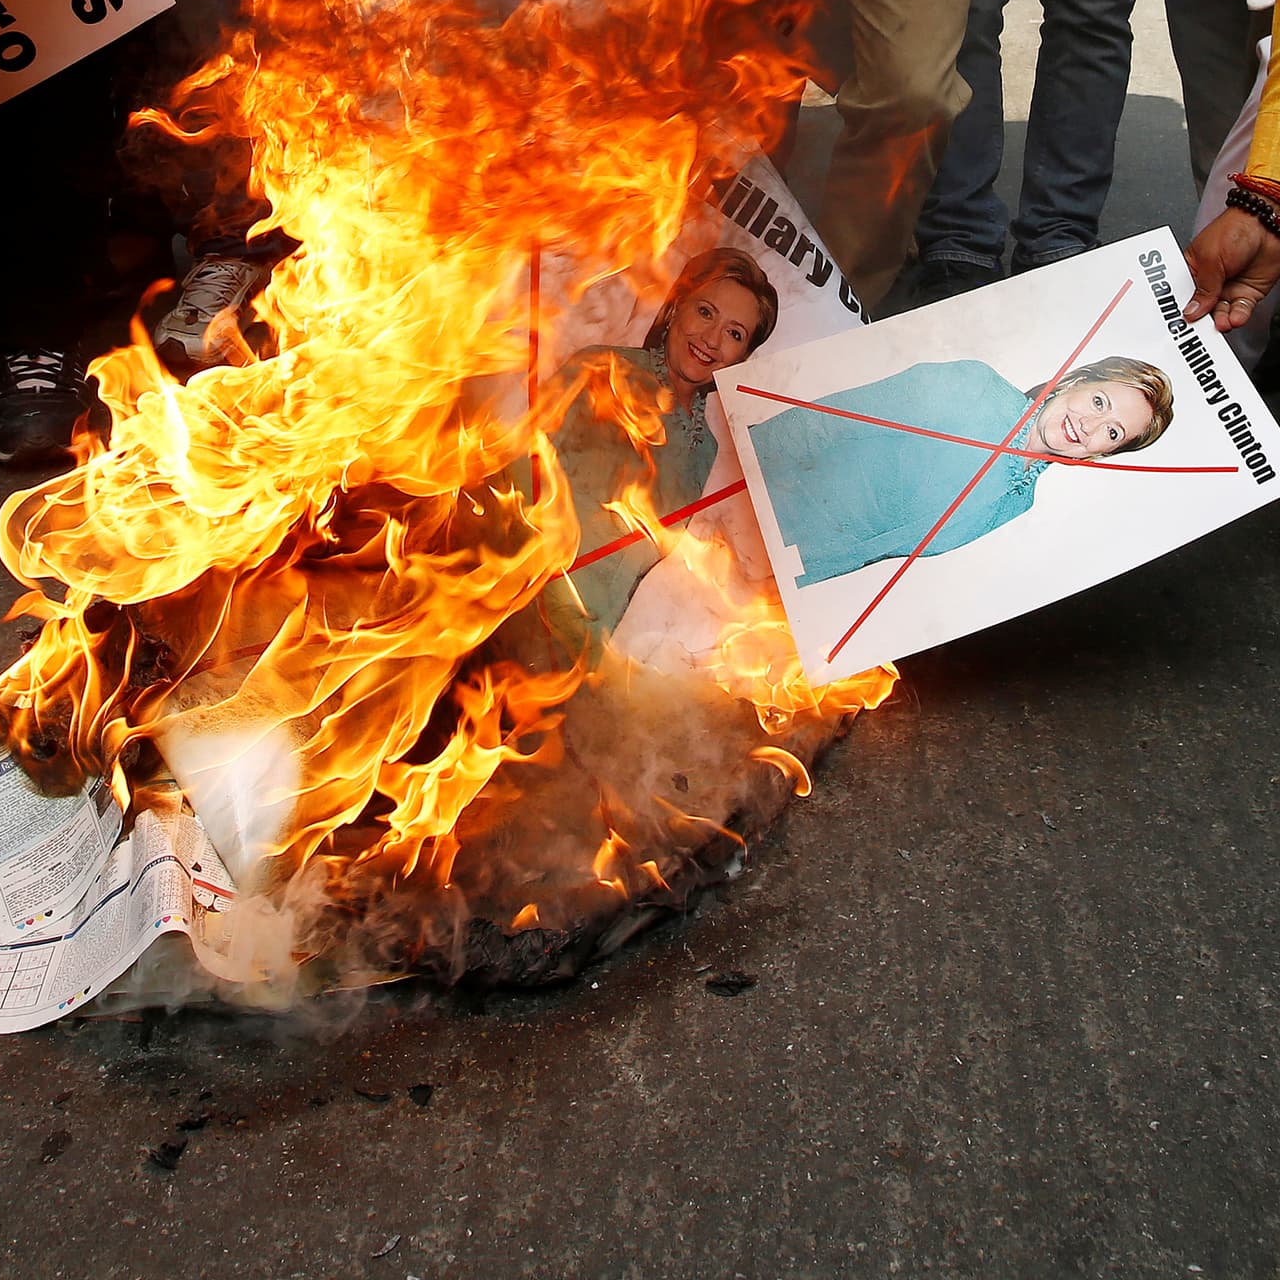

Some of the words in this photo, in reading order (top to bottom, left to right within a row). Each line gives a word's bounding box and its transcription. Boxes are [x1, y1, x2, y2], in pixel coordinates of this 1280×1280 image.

[1138, 249, 1195, 341] Shame!
[1178, 334, 1230, 406] Hillary
[1217, 402, 1277, 485] Clinton
